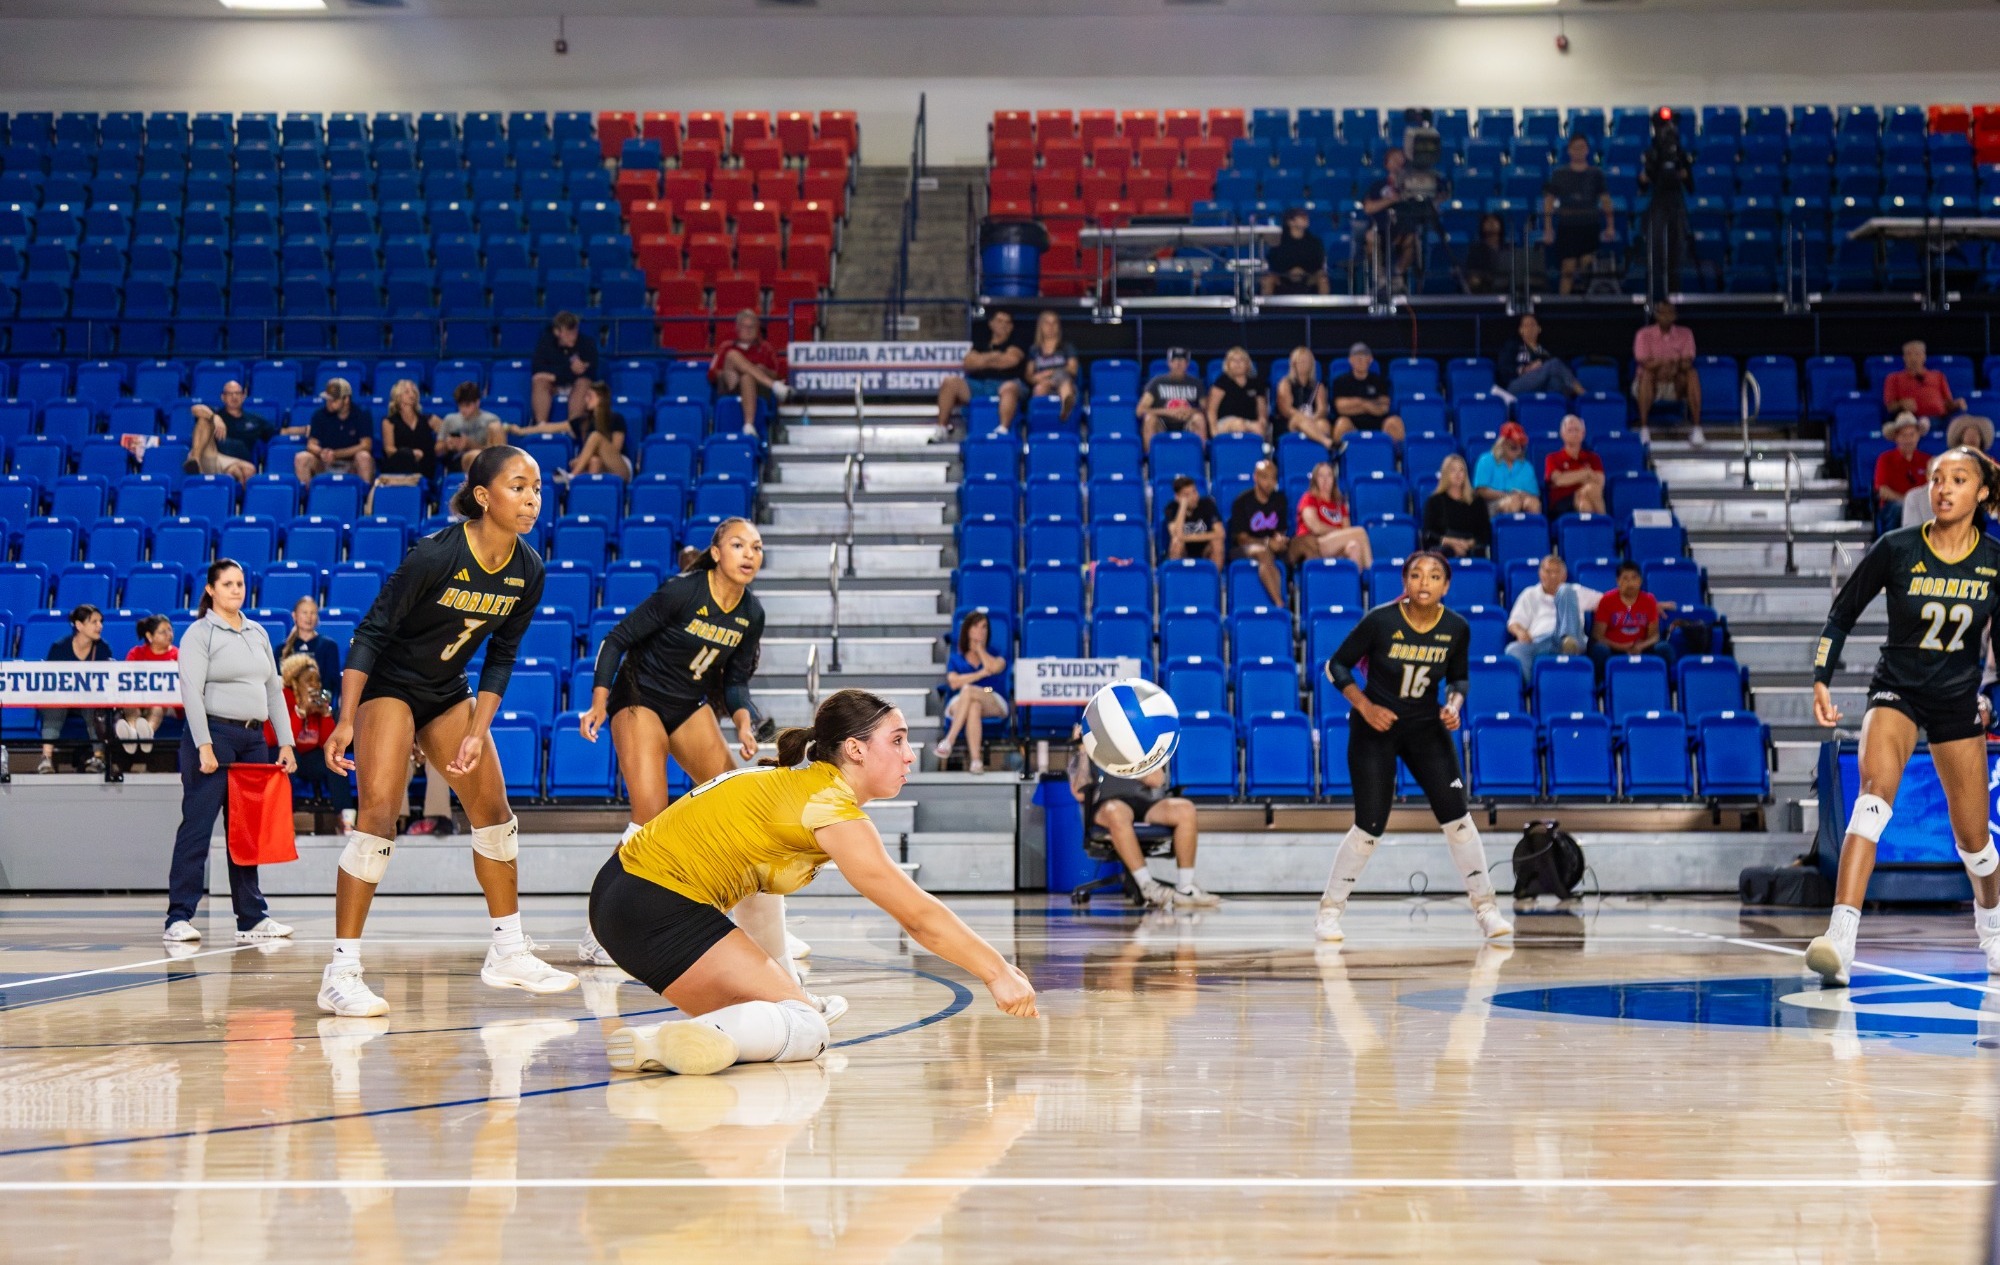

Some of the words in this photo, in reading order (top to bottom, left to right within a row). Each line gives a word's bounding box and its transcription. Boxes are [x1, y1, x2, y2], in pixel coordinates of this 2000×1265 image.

[793, 346, 870, 362] FLORIDA
[876, 346, 967, 362] ATLANTIC
[795, 371, 883, 390] STUDENT
[886, 371, 965, 389] SECTI
[1907, 576, 1990, 601] HORNETS
[1919, 601, 1973, 652] 22
[440, 618, 487, 661] 3
[689, 645, 720, 680] 4
[1388, 643, 1449, 663] HORNETS
[1037, 663, 1120, 677] STUDENT
[1399, 664, 1431, 698] 16
[1041, 683, 1108, 697] SECTIO
